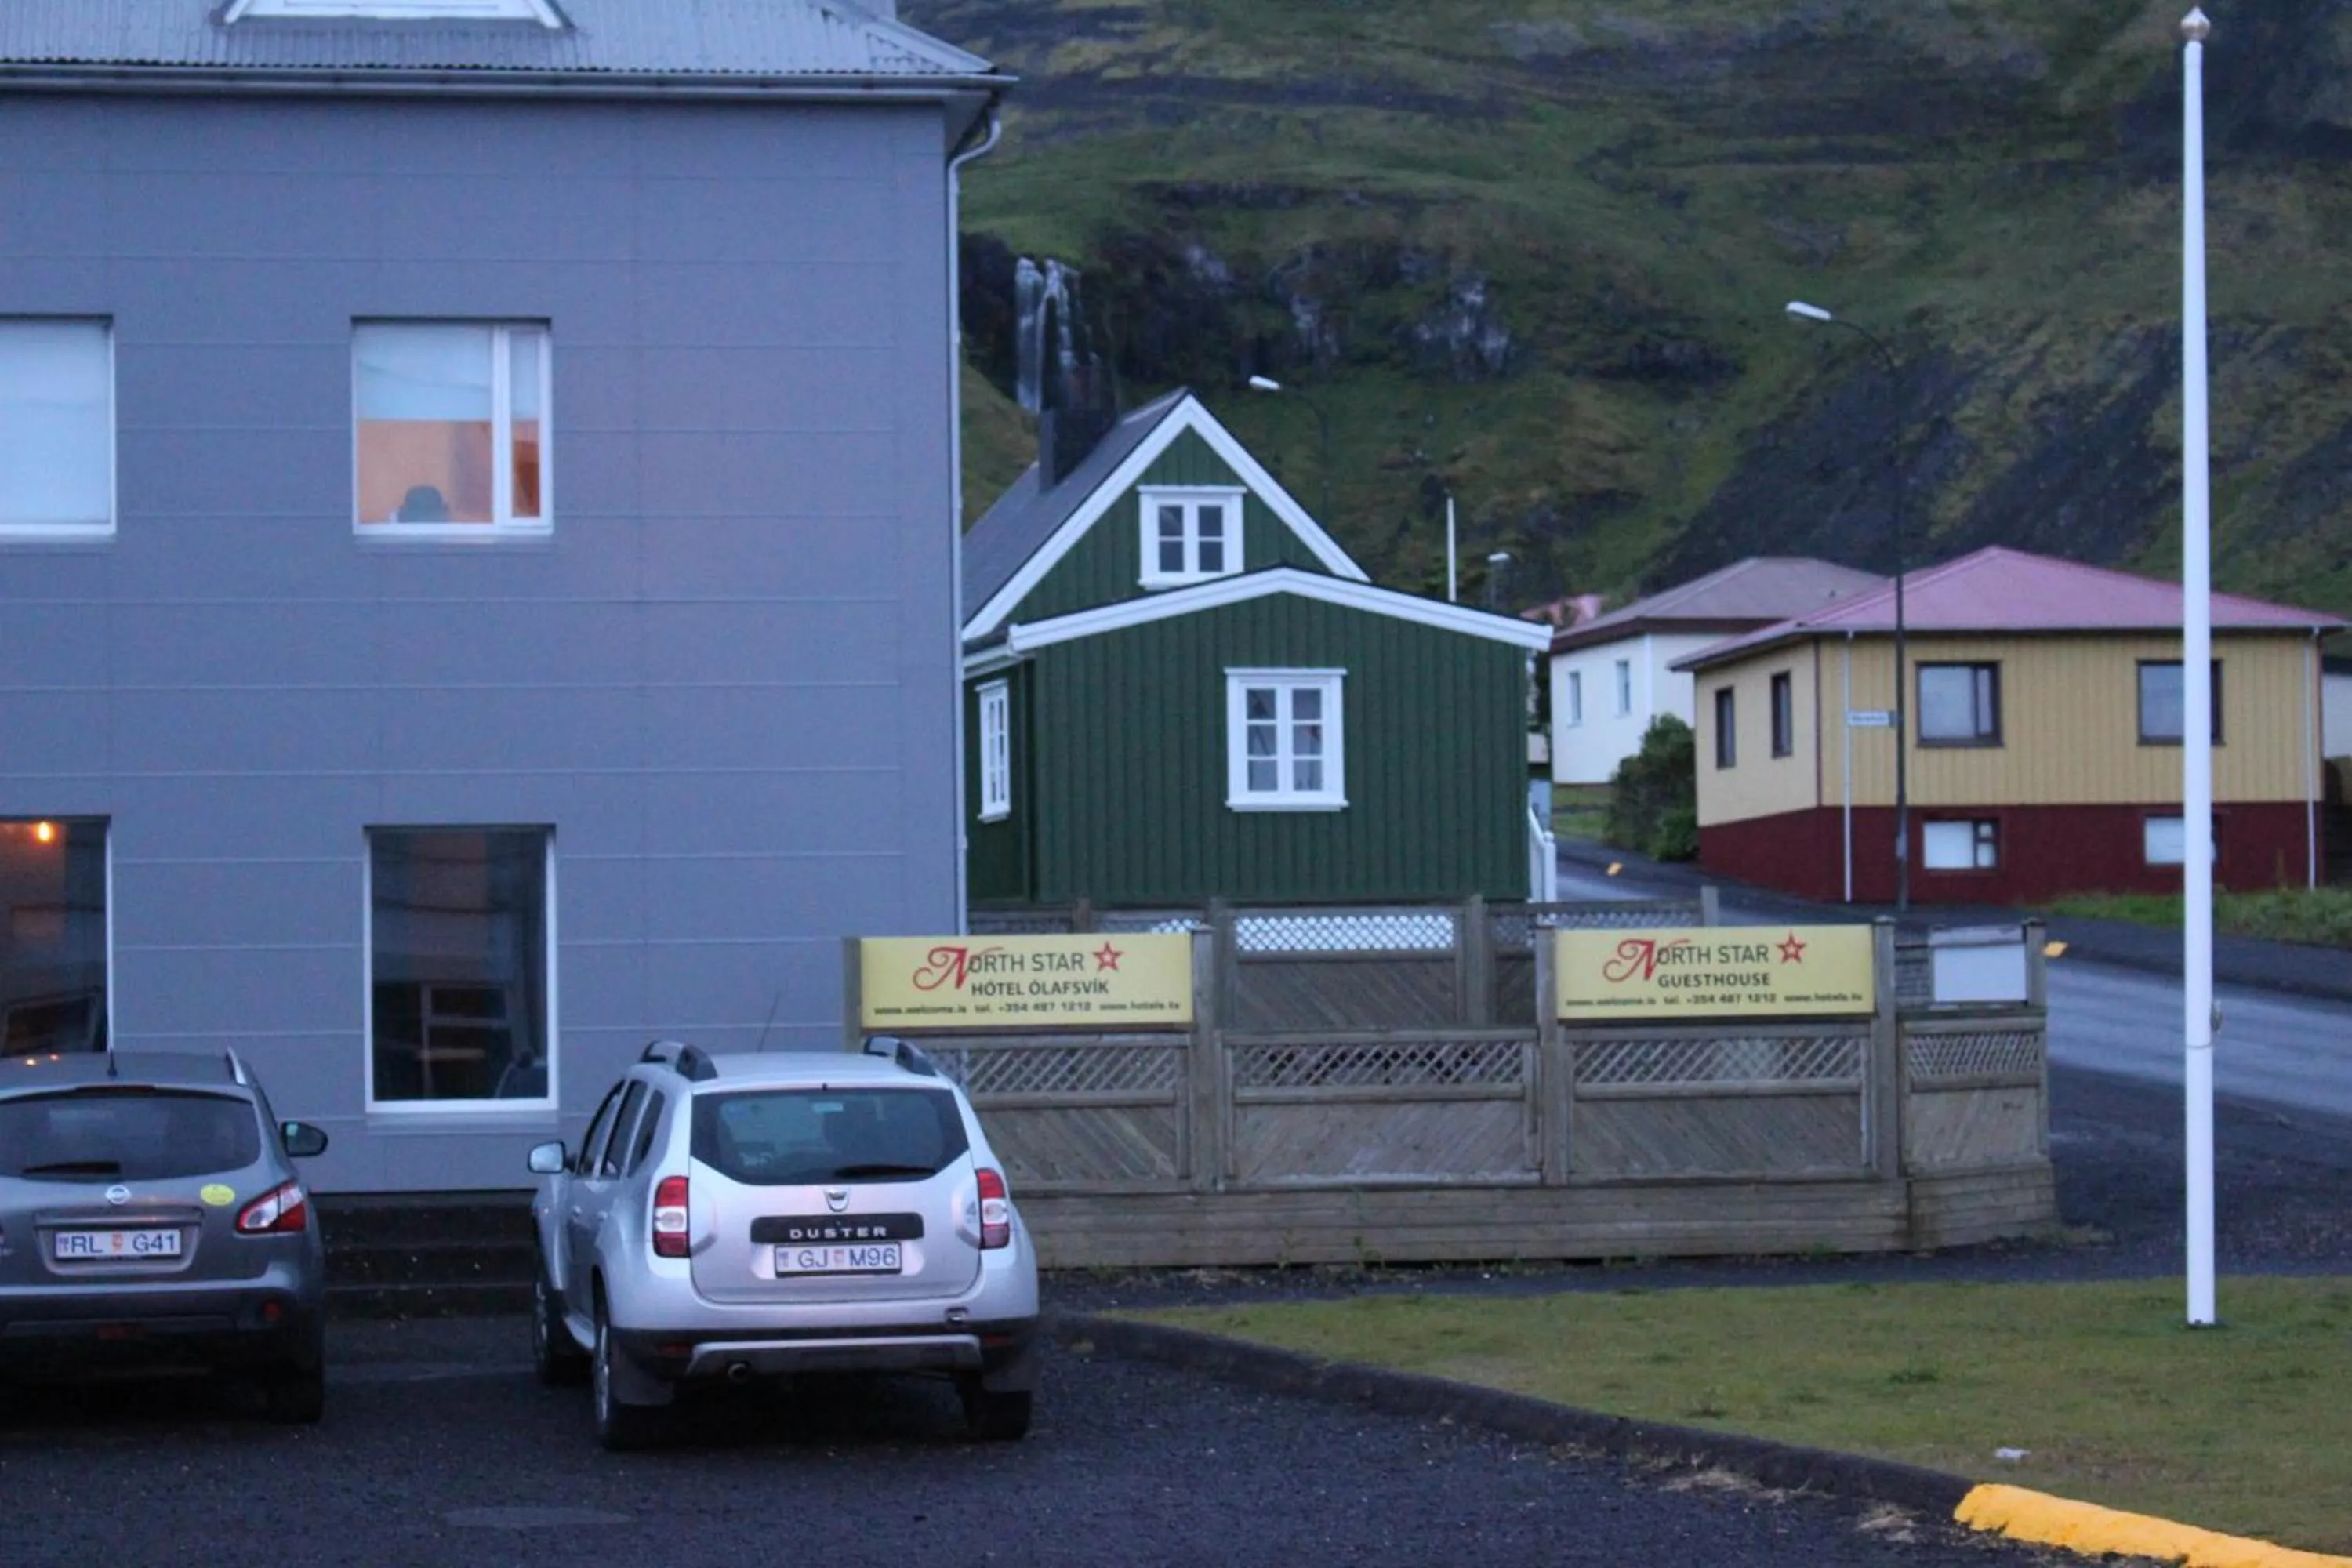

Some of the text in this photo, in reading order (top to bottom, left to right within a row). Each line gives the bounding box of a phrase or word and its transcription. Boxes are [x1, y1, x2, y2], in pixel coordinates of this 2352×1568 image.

[913, 946, 1085, 990] NORTH STAR
[1602, 938, 1769, 982] NORTH STAR
[1657, 972, 1771, 989] GUESTHOUSE
[789, 1226, 887, 1240] DUSTER
[71, 1234, 176, 1254] RL G41
[797, 1247, 898, 1269] GJ M96
